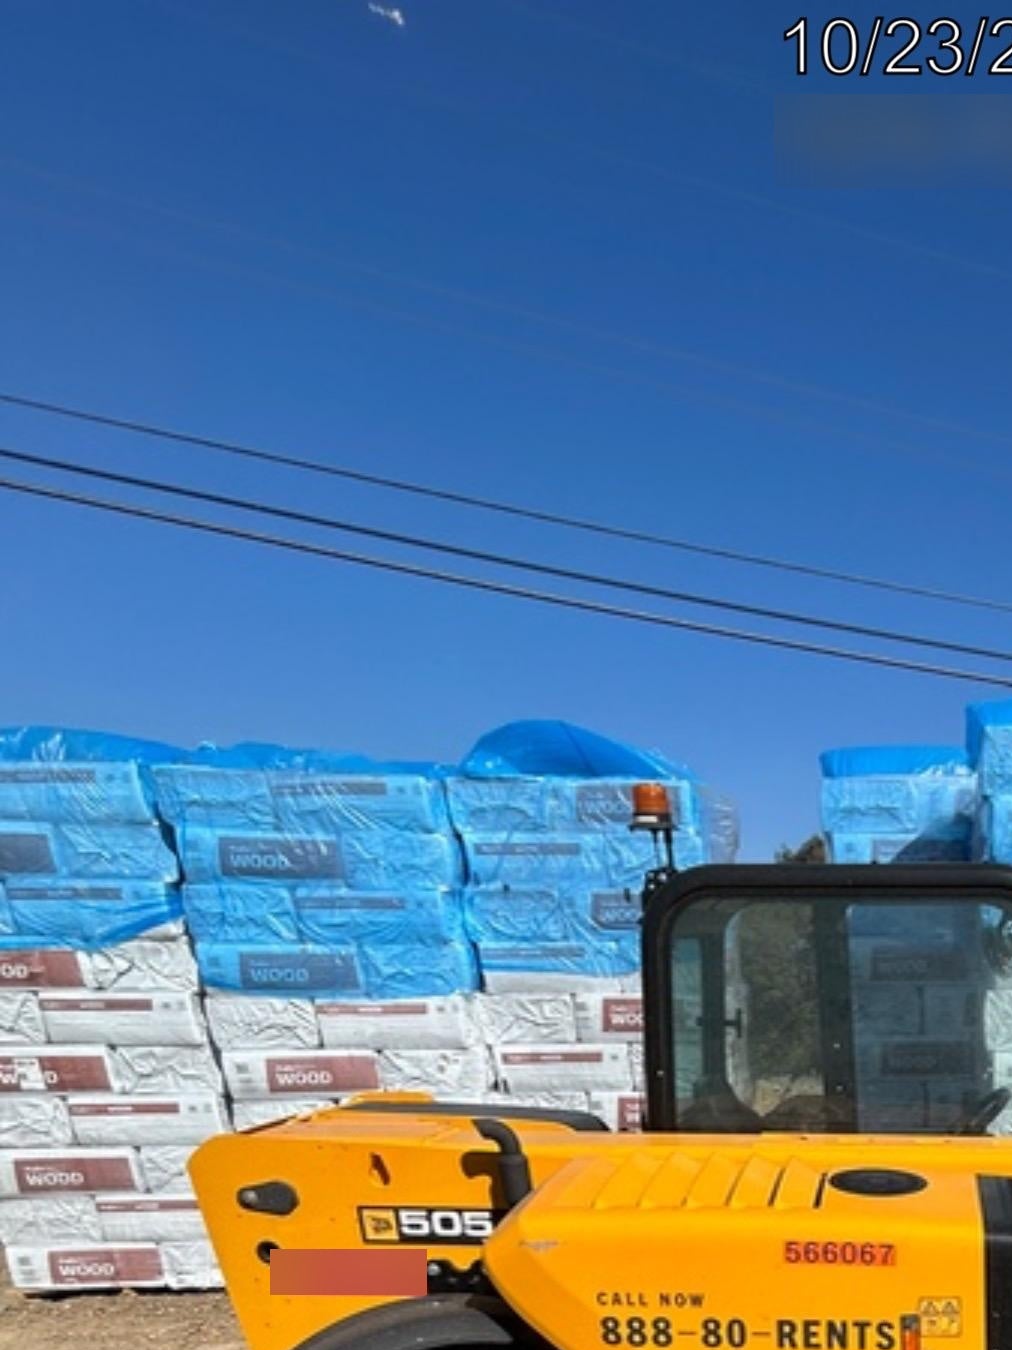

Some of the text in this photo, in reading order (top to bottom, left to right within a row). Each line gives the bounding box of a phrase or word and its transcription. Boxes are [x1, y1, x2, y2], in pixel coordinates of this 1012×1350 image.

[250, 967, 309, 982] WOOD
[276, 1070, 333, 1085] WOOD
[25, 1171, 84, 1186] WOOD
[399, 1209, 492, 1237] 505
[784, 1241, 895, 1266] 566067
[58, 1262, 114, 1277] WOOD
[596, 1291, 705, 1308] CALL NOW
[600, 1316, 896, 1350] 888-80-RENTS
